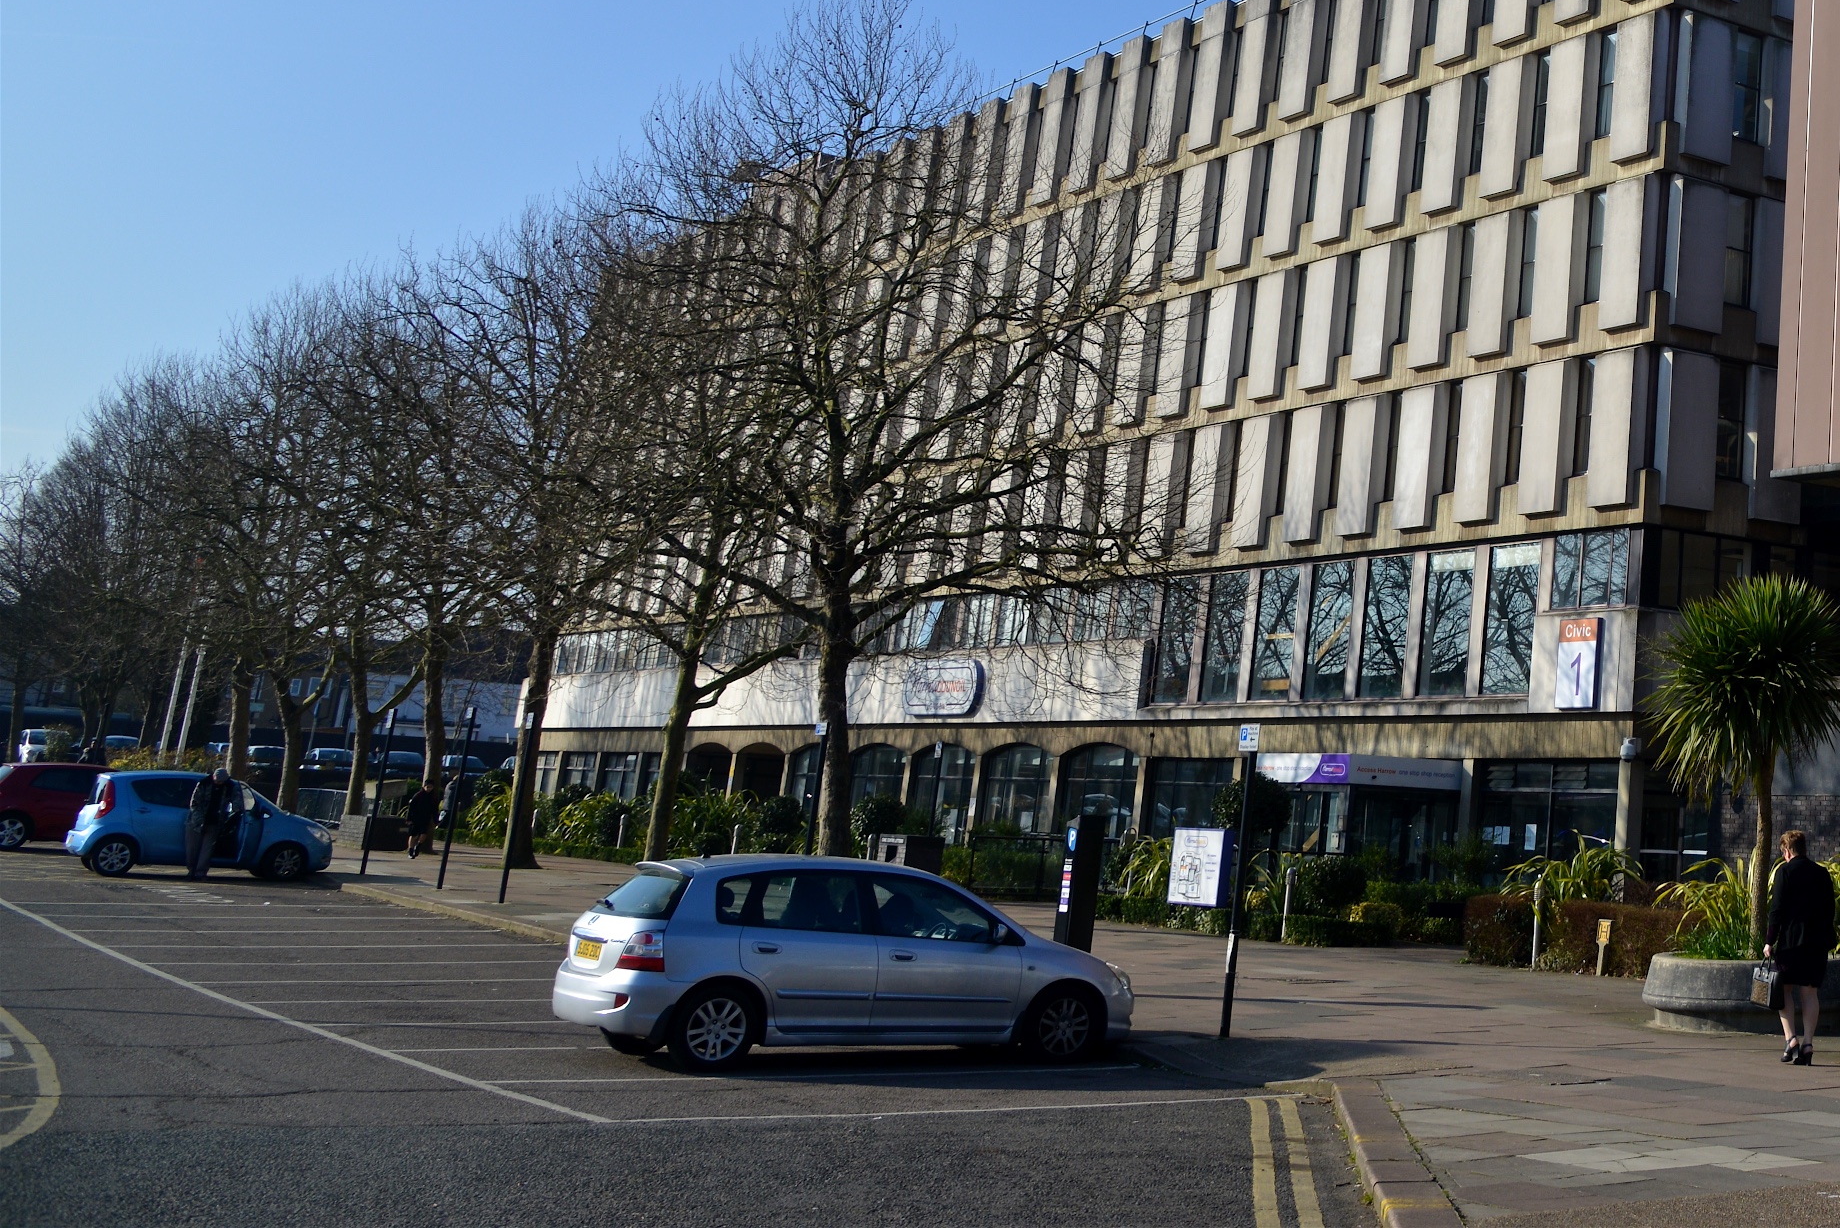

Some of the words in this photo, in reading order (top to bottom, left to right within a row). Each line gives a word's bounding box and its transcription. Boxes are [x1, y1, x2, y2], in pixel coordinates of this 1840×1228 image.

[1565, 624, 1592, 638] Civic
[1571, 652, 1581, 696] 1
[1378, 767, 1396, 775] Harrow
[1069, 830, 1076, 847] P
